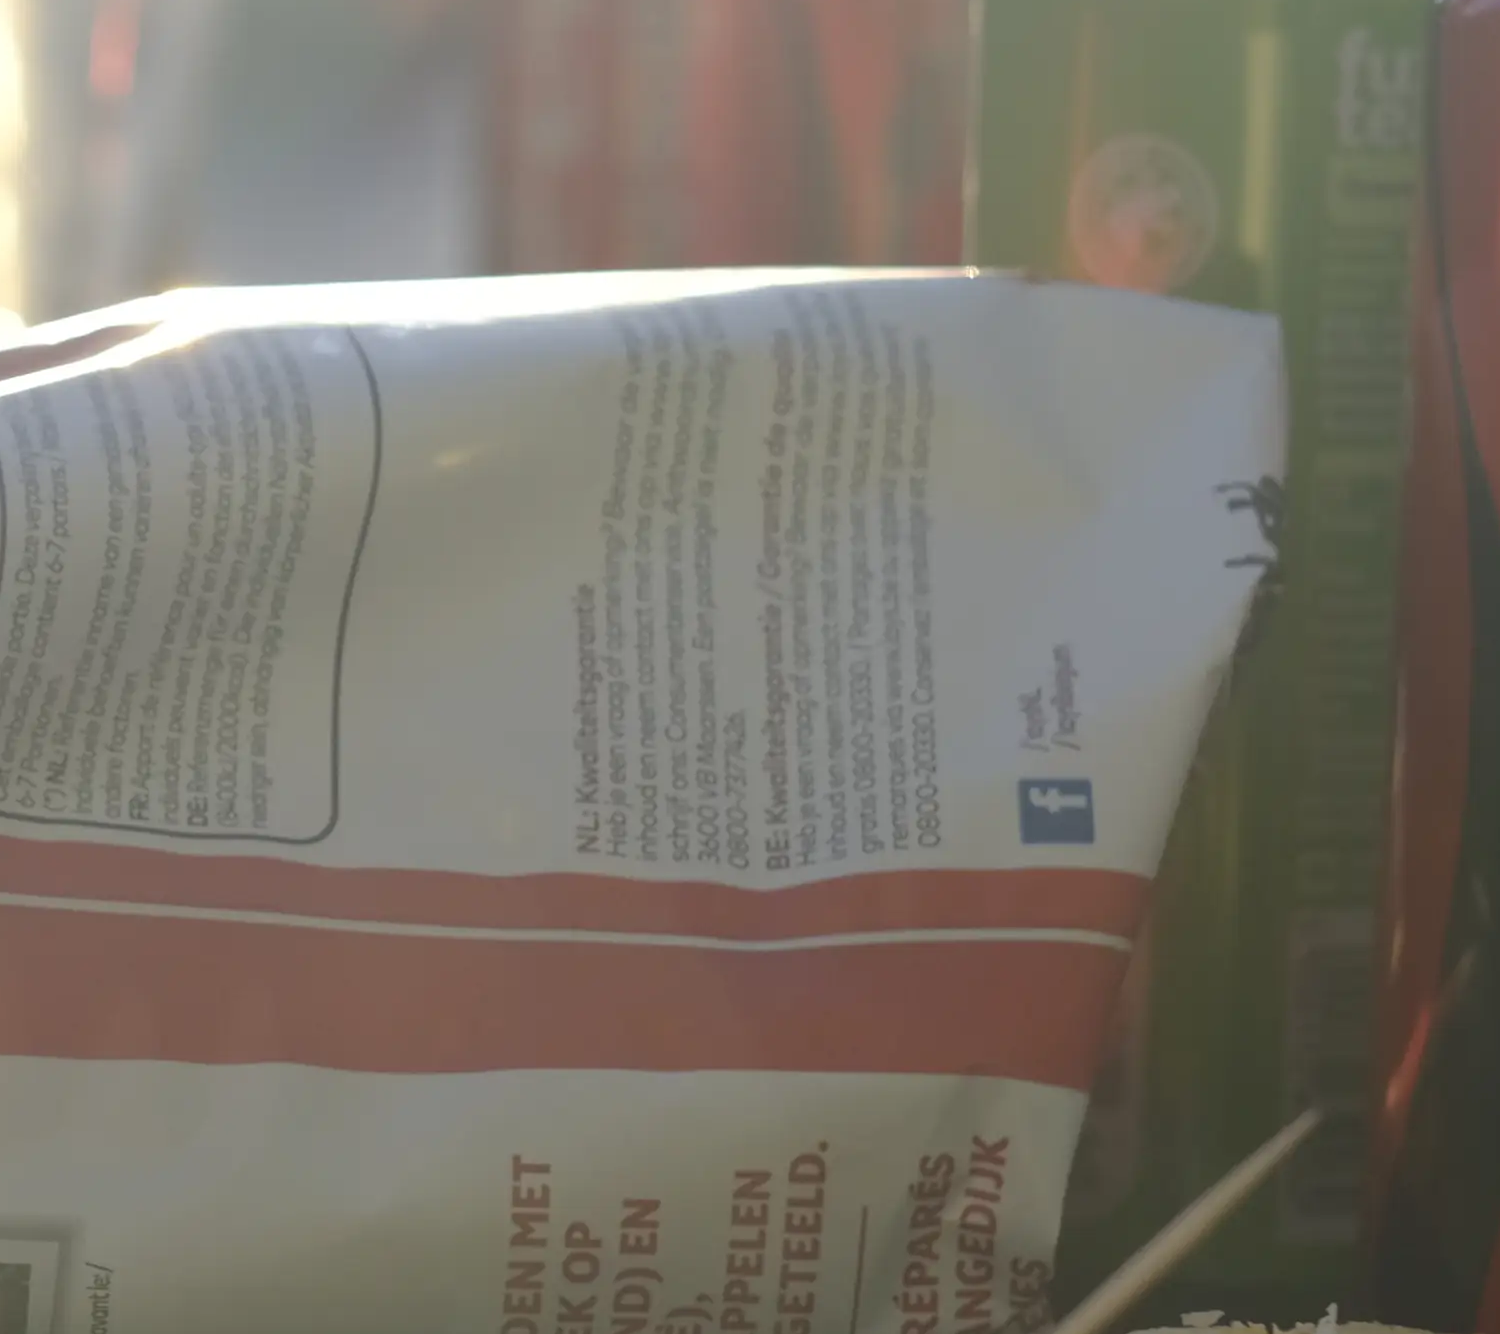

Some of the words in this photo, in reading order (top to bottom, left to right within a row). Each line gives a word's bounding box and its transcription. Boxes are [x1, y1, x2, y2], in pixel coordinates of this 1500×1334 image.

[574, 809, 599, 854] NL:
[696, 803, 720, 864] 3600
[765, 827, 790, 872] BE:
[509, 1153, 553, 1249] MET
[620, 1196, 663, 1258] EN
[560, 1220, 605, 1284] OP
